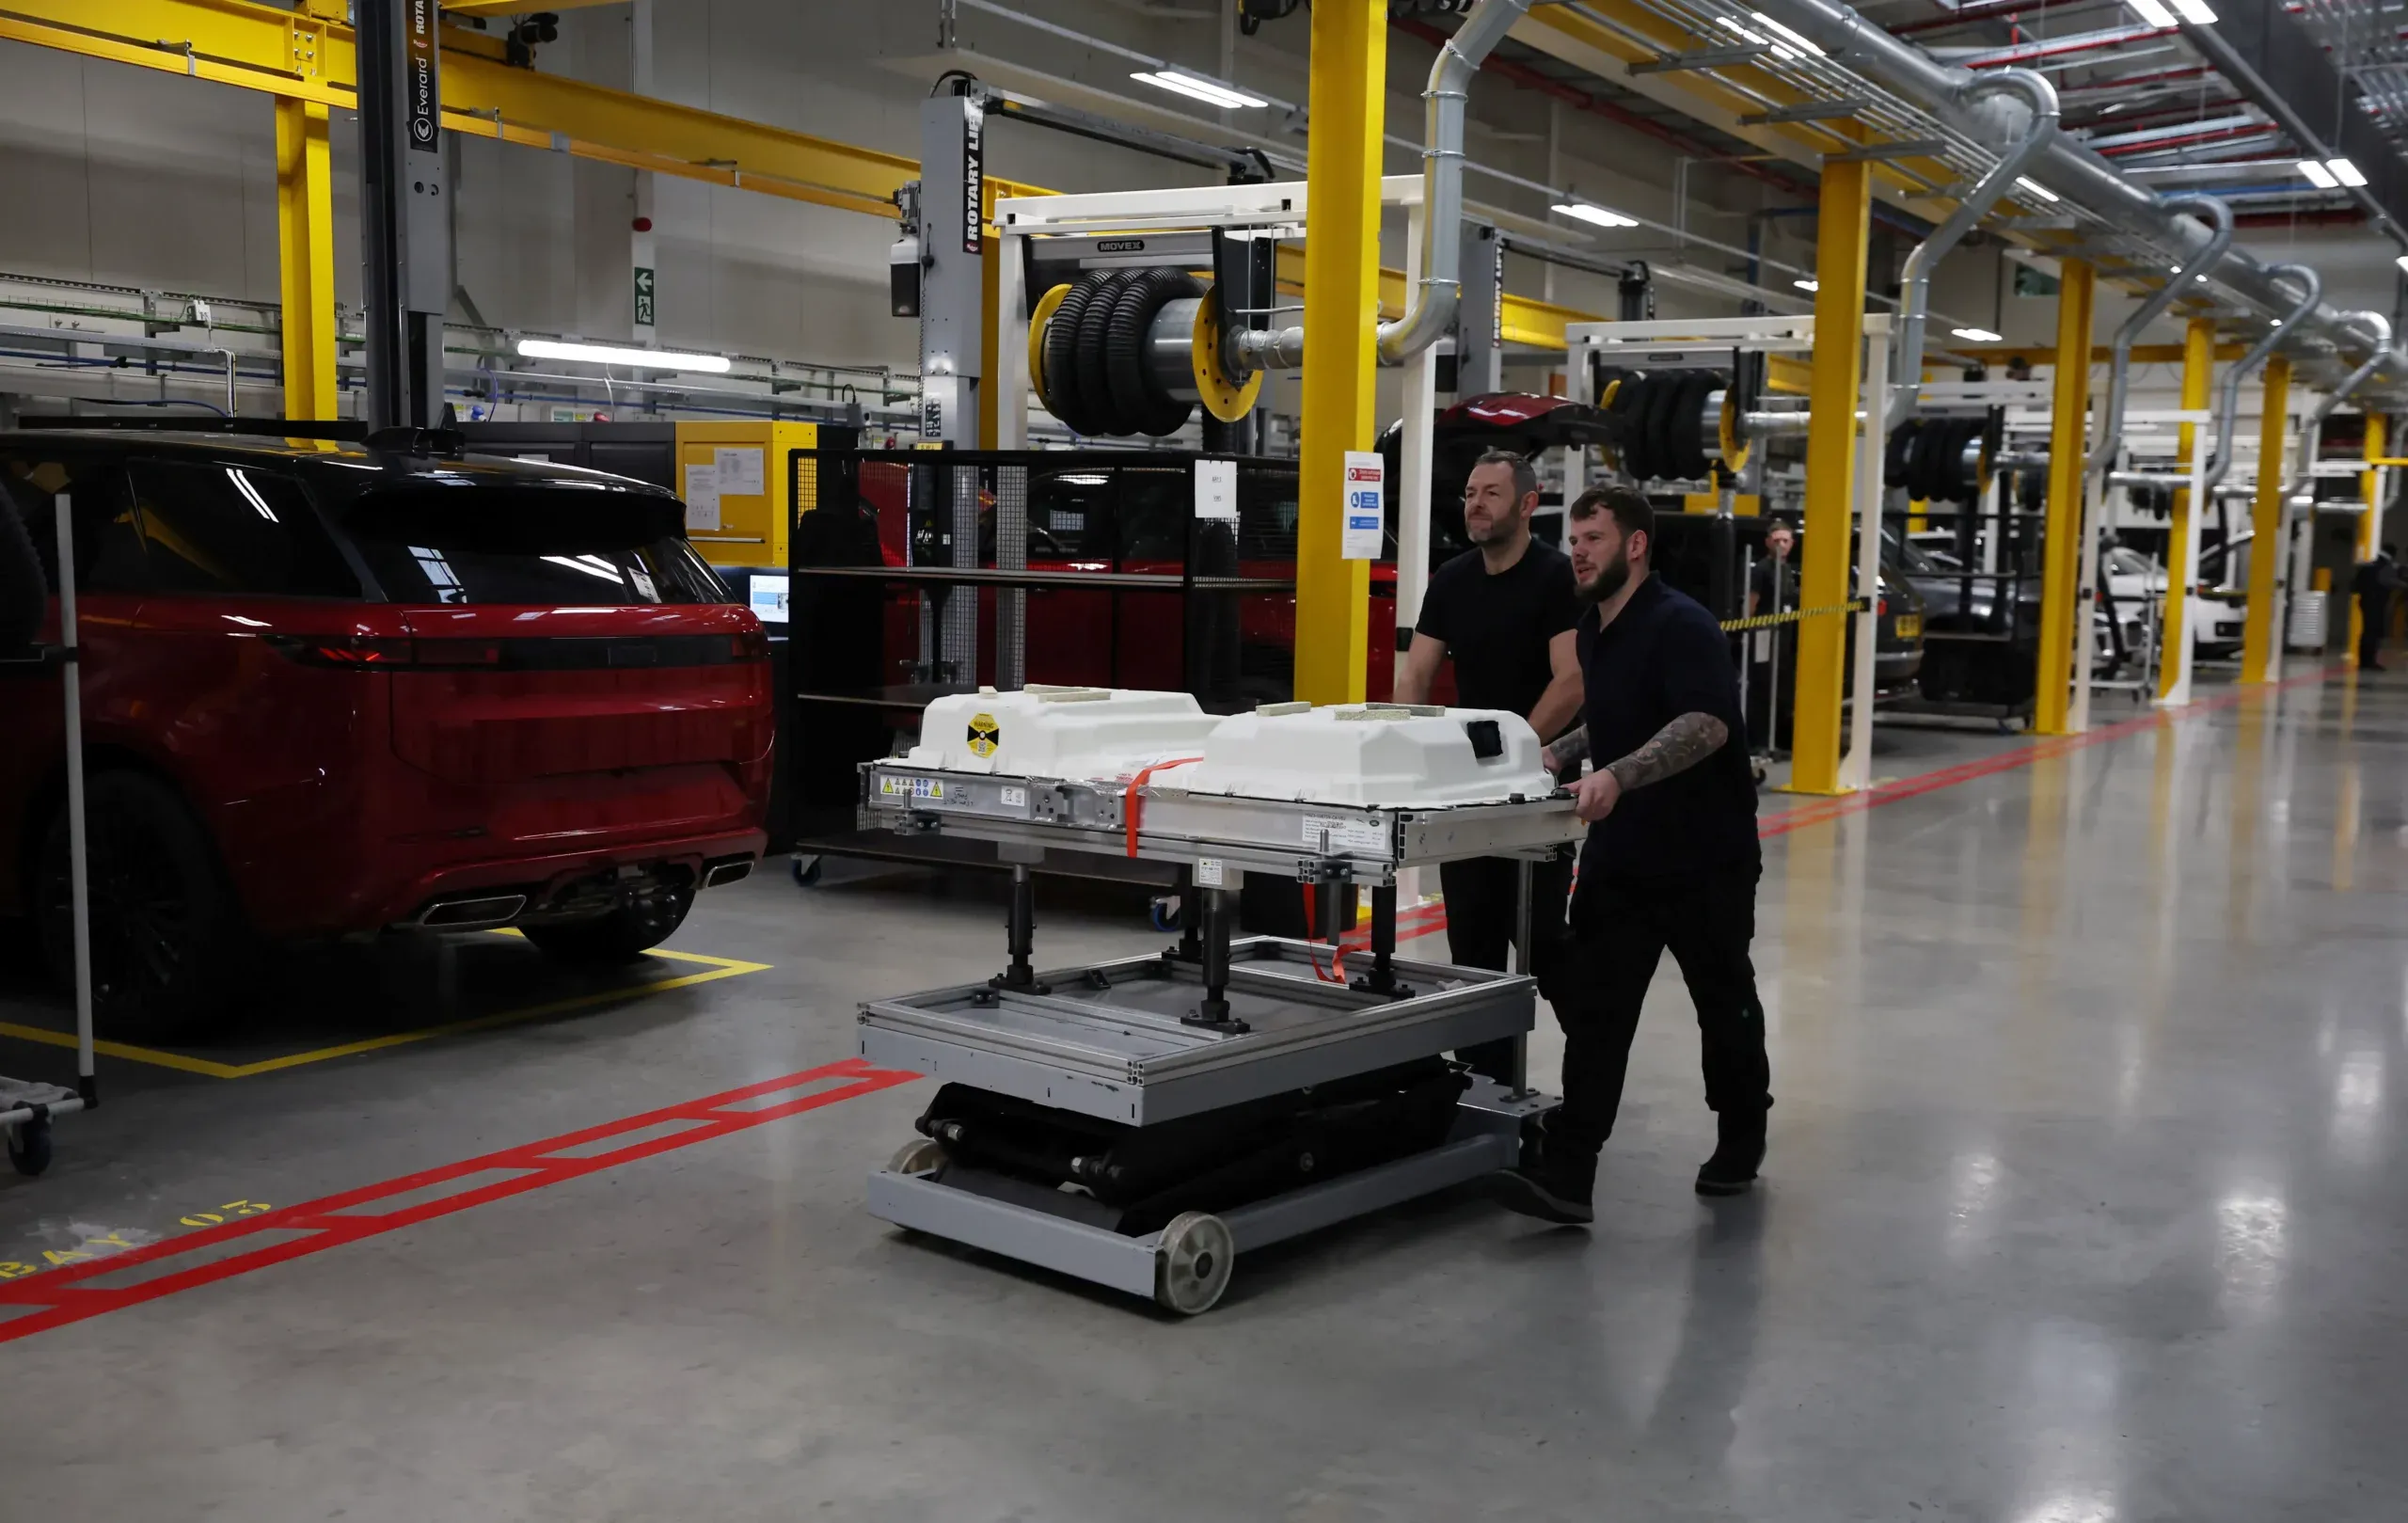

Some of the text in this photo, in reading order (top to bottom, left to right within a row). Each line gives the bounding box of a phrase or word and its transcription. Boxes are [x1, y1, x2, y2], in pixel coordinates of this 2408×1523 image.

[415, 56, 429, 115] Everard
[968, 103, 979, 151] LIF
[967, 154, 979, 241] ROTARY
[1100, 241, 1141, 251] MOVEX
[180, 1199, 272, 1227] 03
